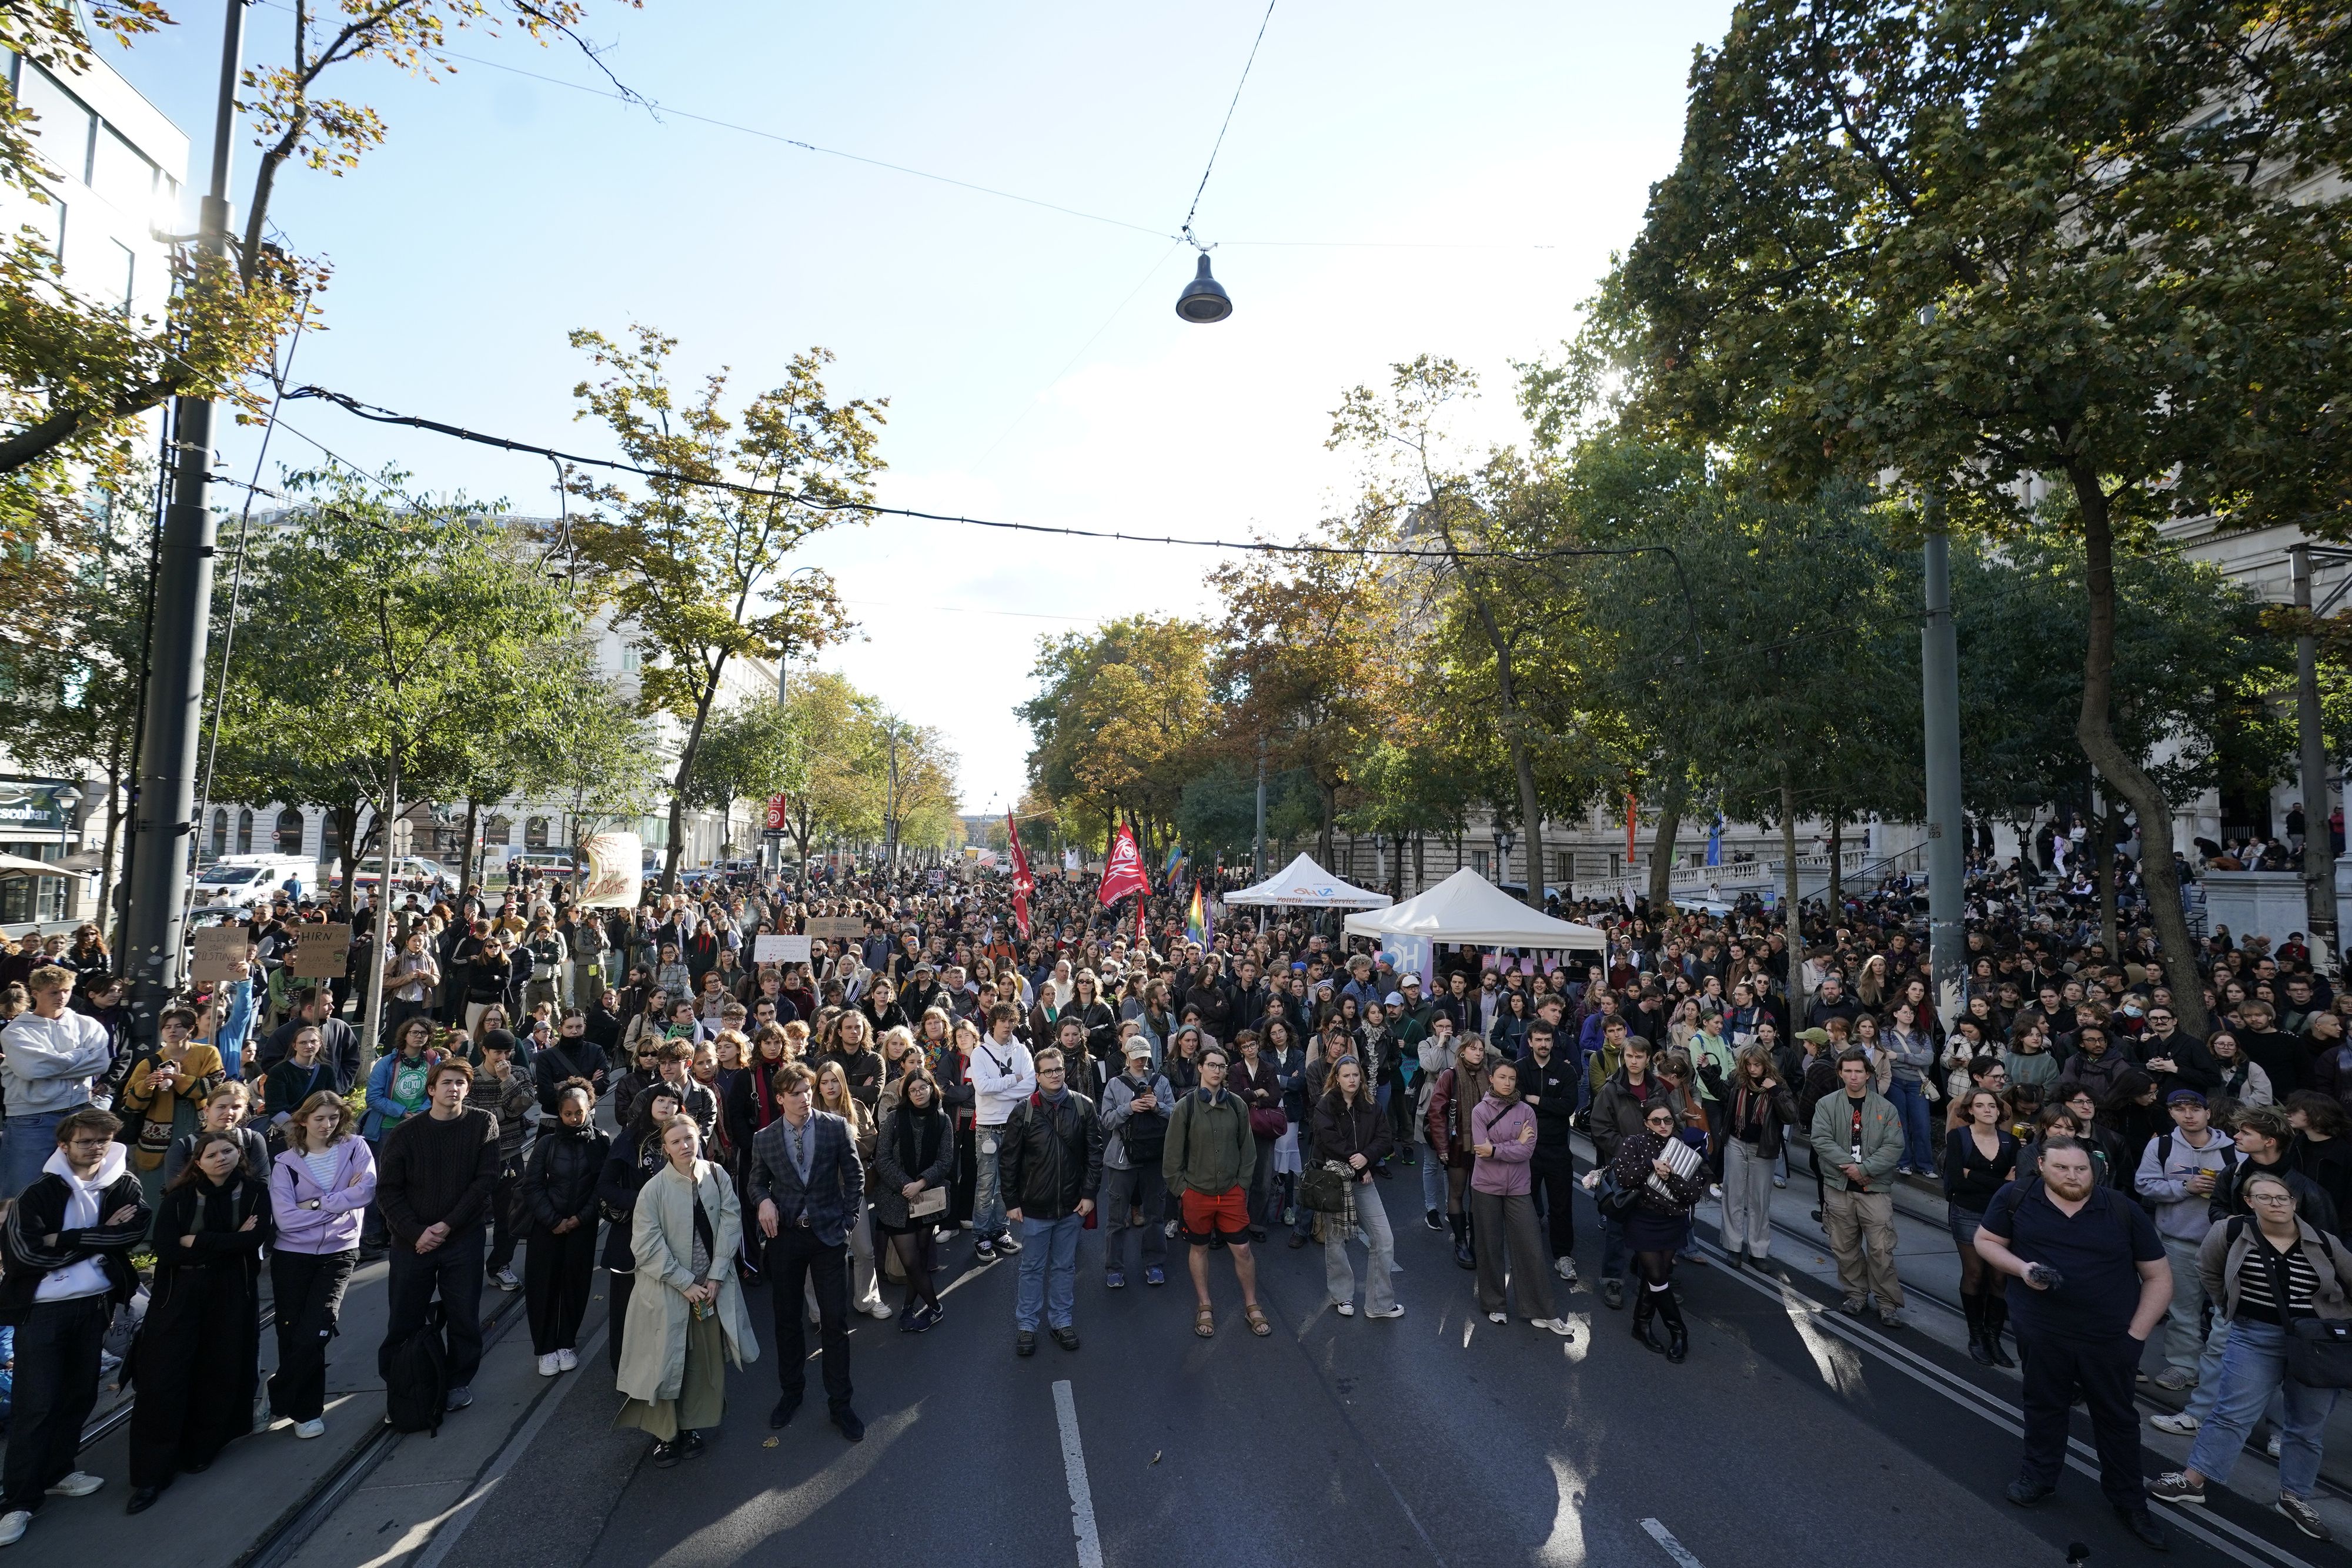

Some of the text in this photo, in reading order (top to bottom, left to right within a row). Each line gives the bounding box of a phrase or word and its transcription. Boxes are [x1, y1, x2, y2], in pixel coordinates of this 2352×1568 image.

[0, 804, 51, 820] scobar
[198, 932, 240, 942] BILDUNG
[302, 931, 333, 942] HIRN
[195, 951, 236, 961] RÜSTUNG
[402, 1079, 421, 1089] BOKU
